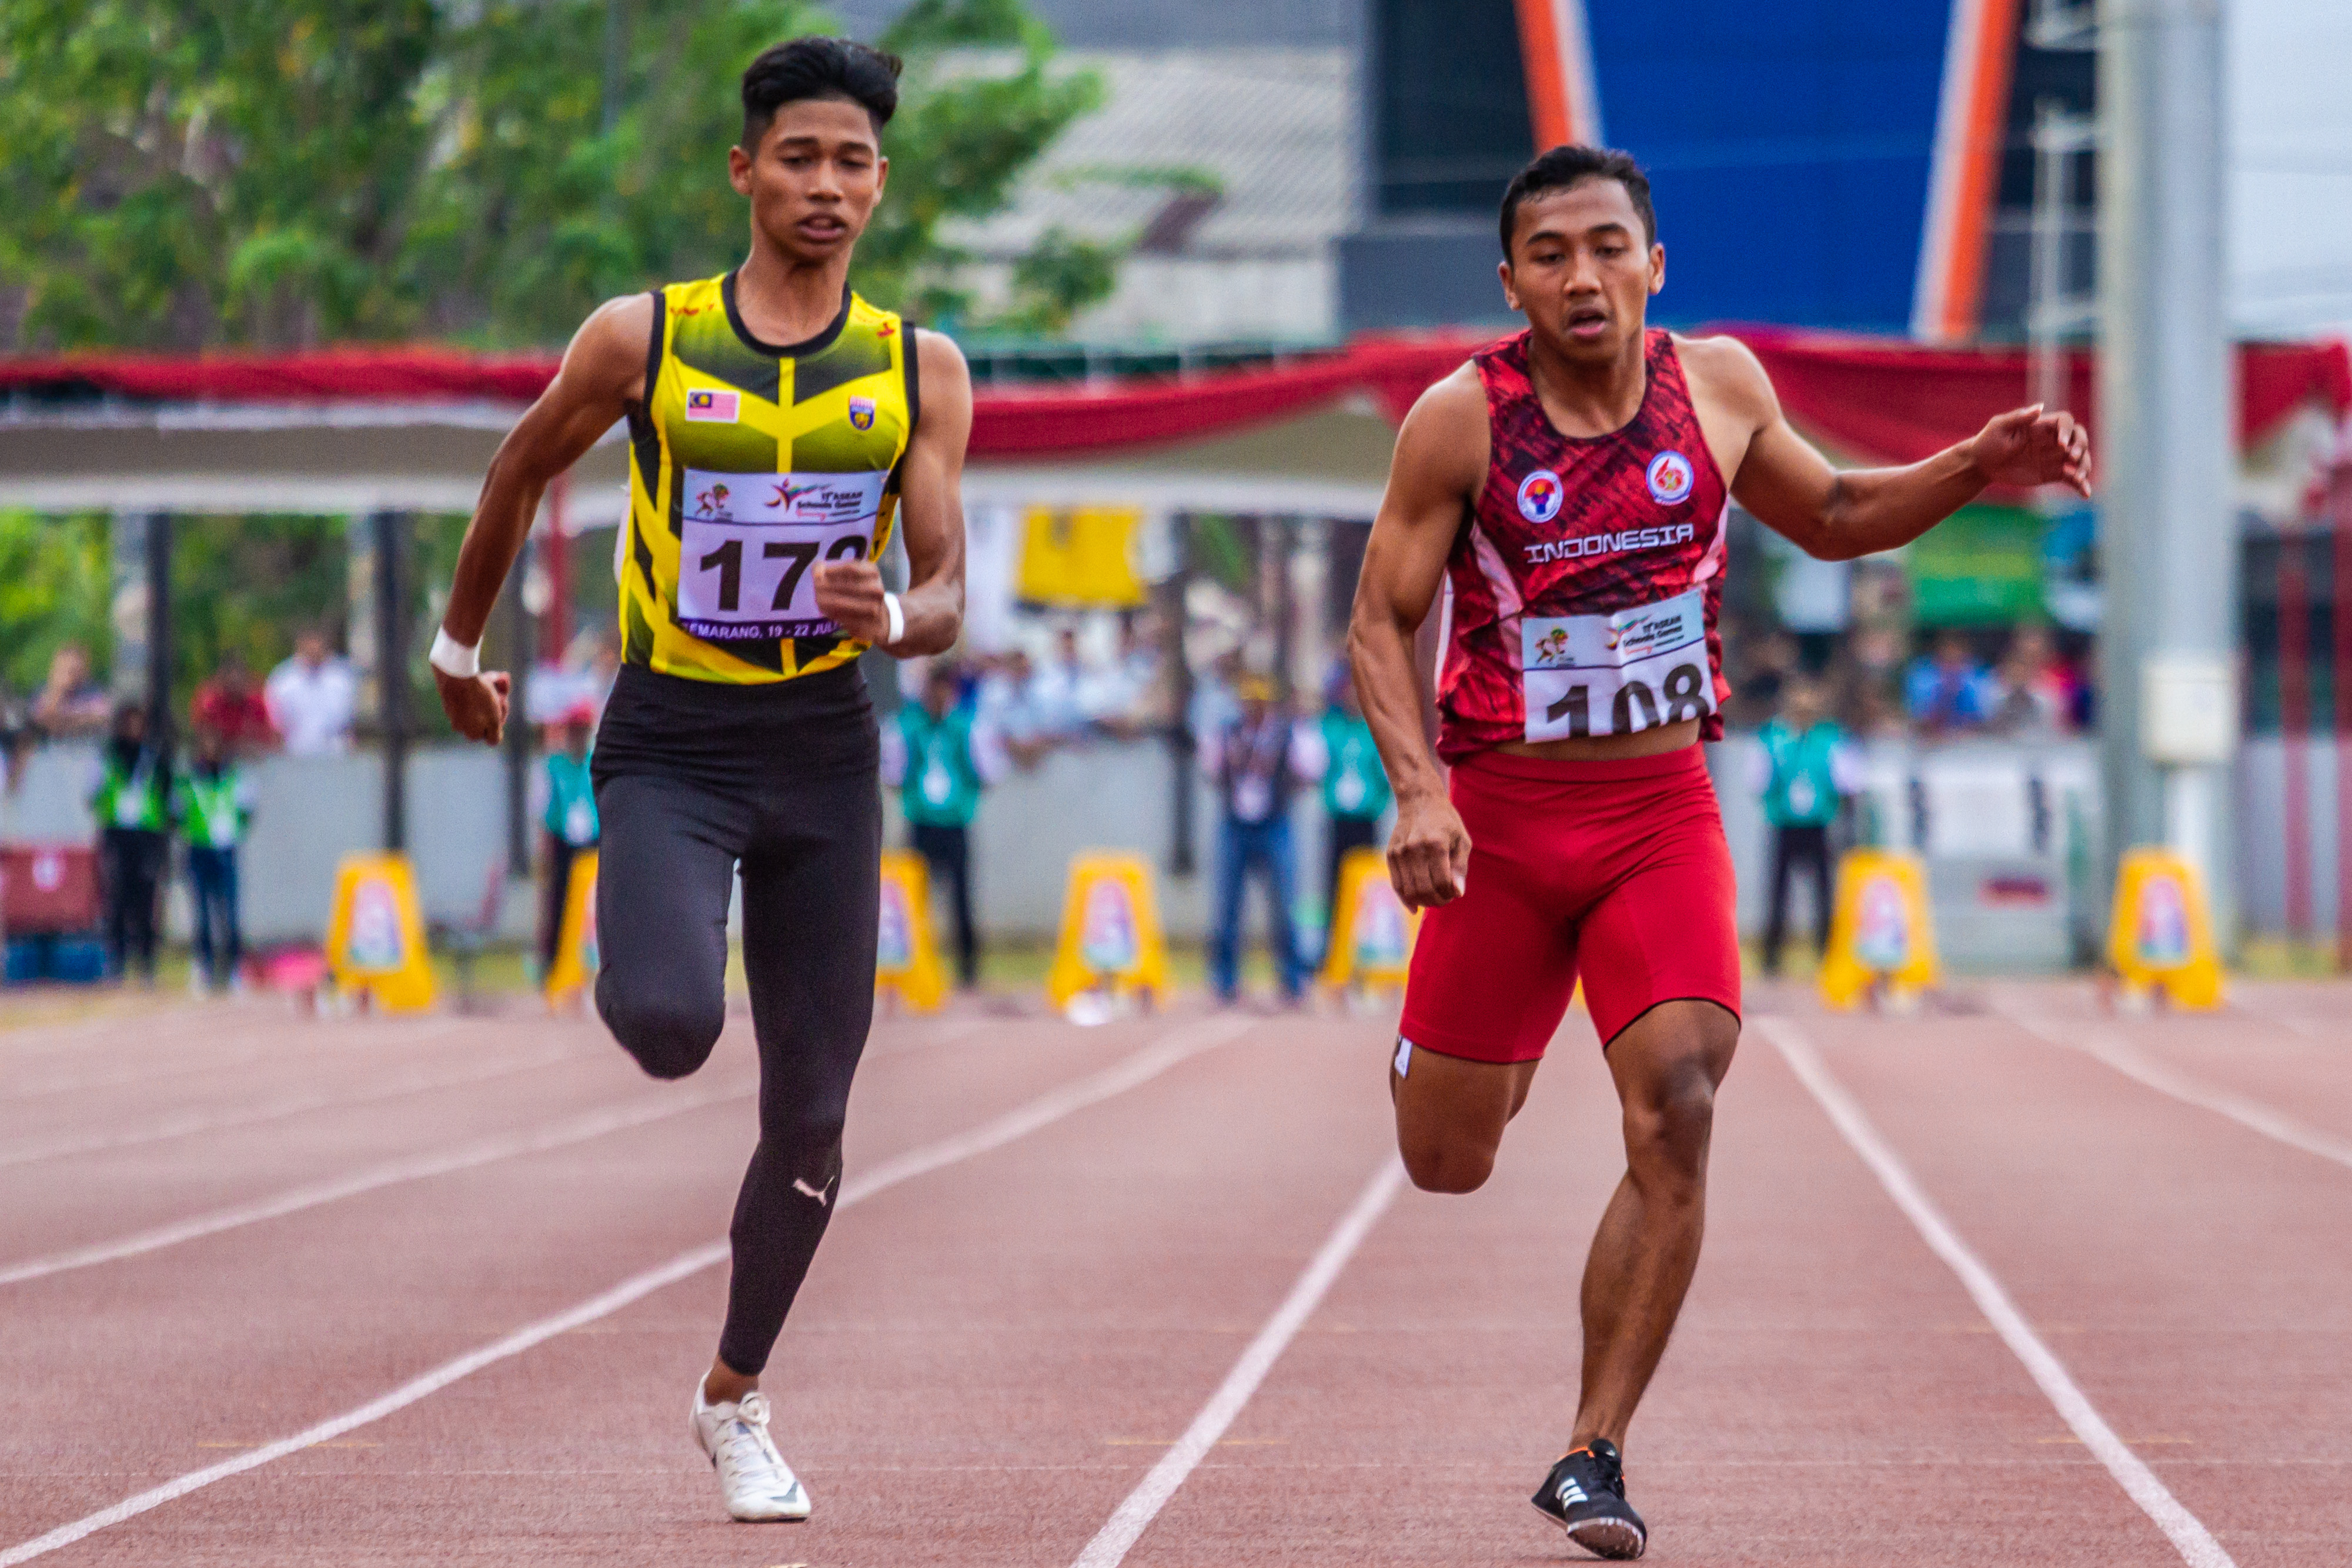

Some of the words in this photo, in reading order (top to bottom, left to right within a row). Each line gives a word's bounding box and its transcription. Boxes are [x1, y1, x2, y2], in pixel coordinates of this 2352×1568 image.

[1524, 523, 1694, 563] INDONESIA
[769, 624, 783, 637] 19
[794, 624, 810, 637] 22
[1546, 663, 1710, 738] 108
